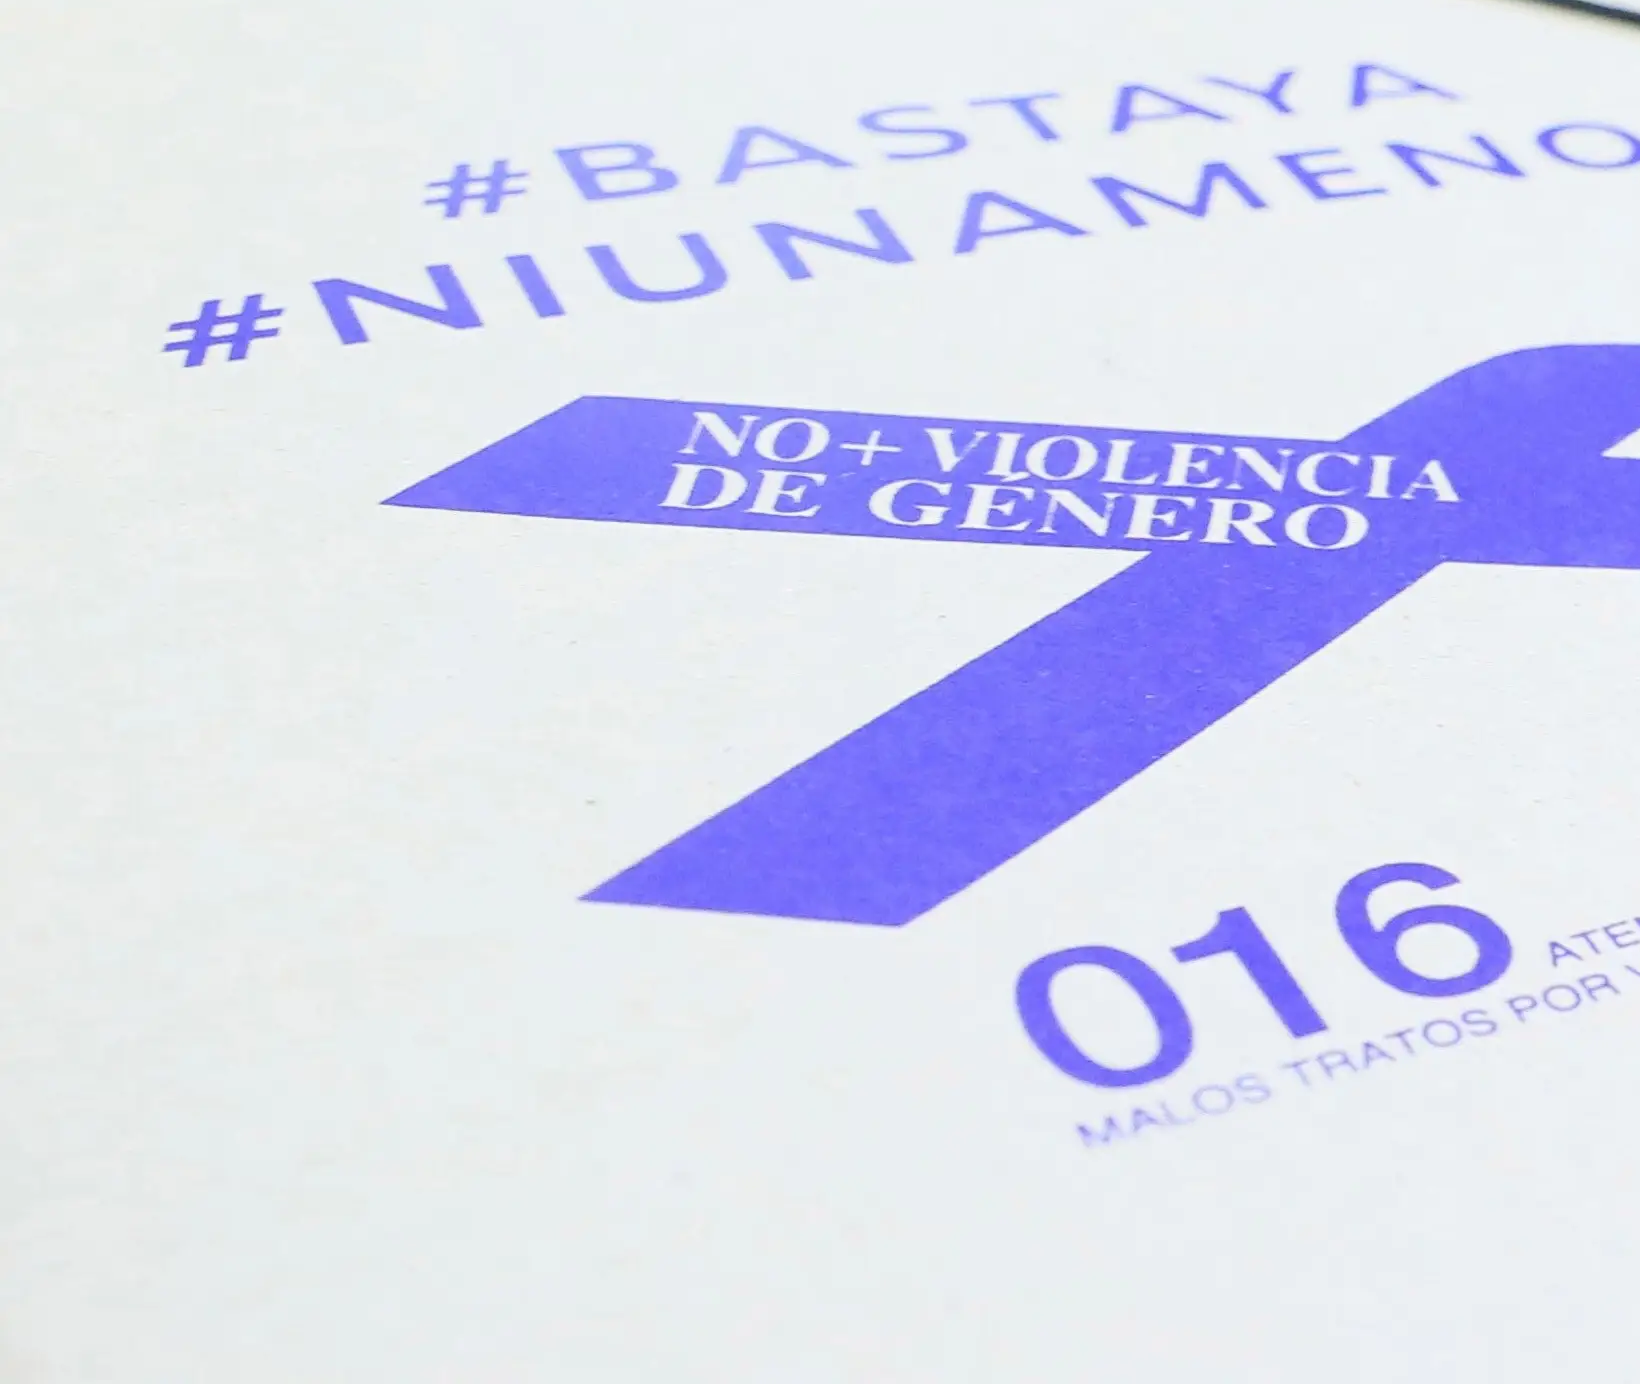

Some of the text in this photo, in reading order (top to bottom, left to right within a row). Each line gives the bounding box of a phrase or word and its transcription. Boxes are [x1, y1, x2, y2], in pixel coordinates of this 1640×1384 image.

[425, 61, 1456, 221] #BASTAYA
[656, 462, 1370, 550] DE GÉNERO
[1012, 860, 1514, 1092] 016
[1073, 1073, 1272, 1148] MALOS
[1281, 1007, 1499, 1088] TRATOS
[1505, 972, 1622, 1022] POR
